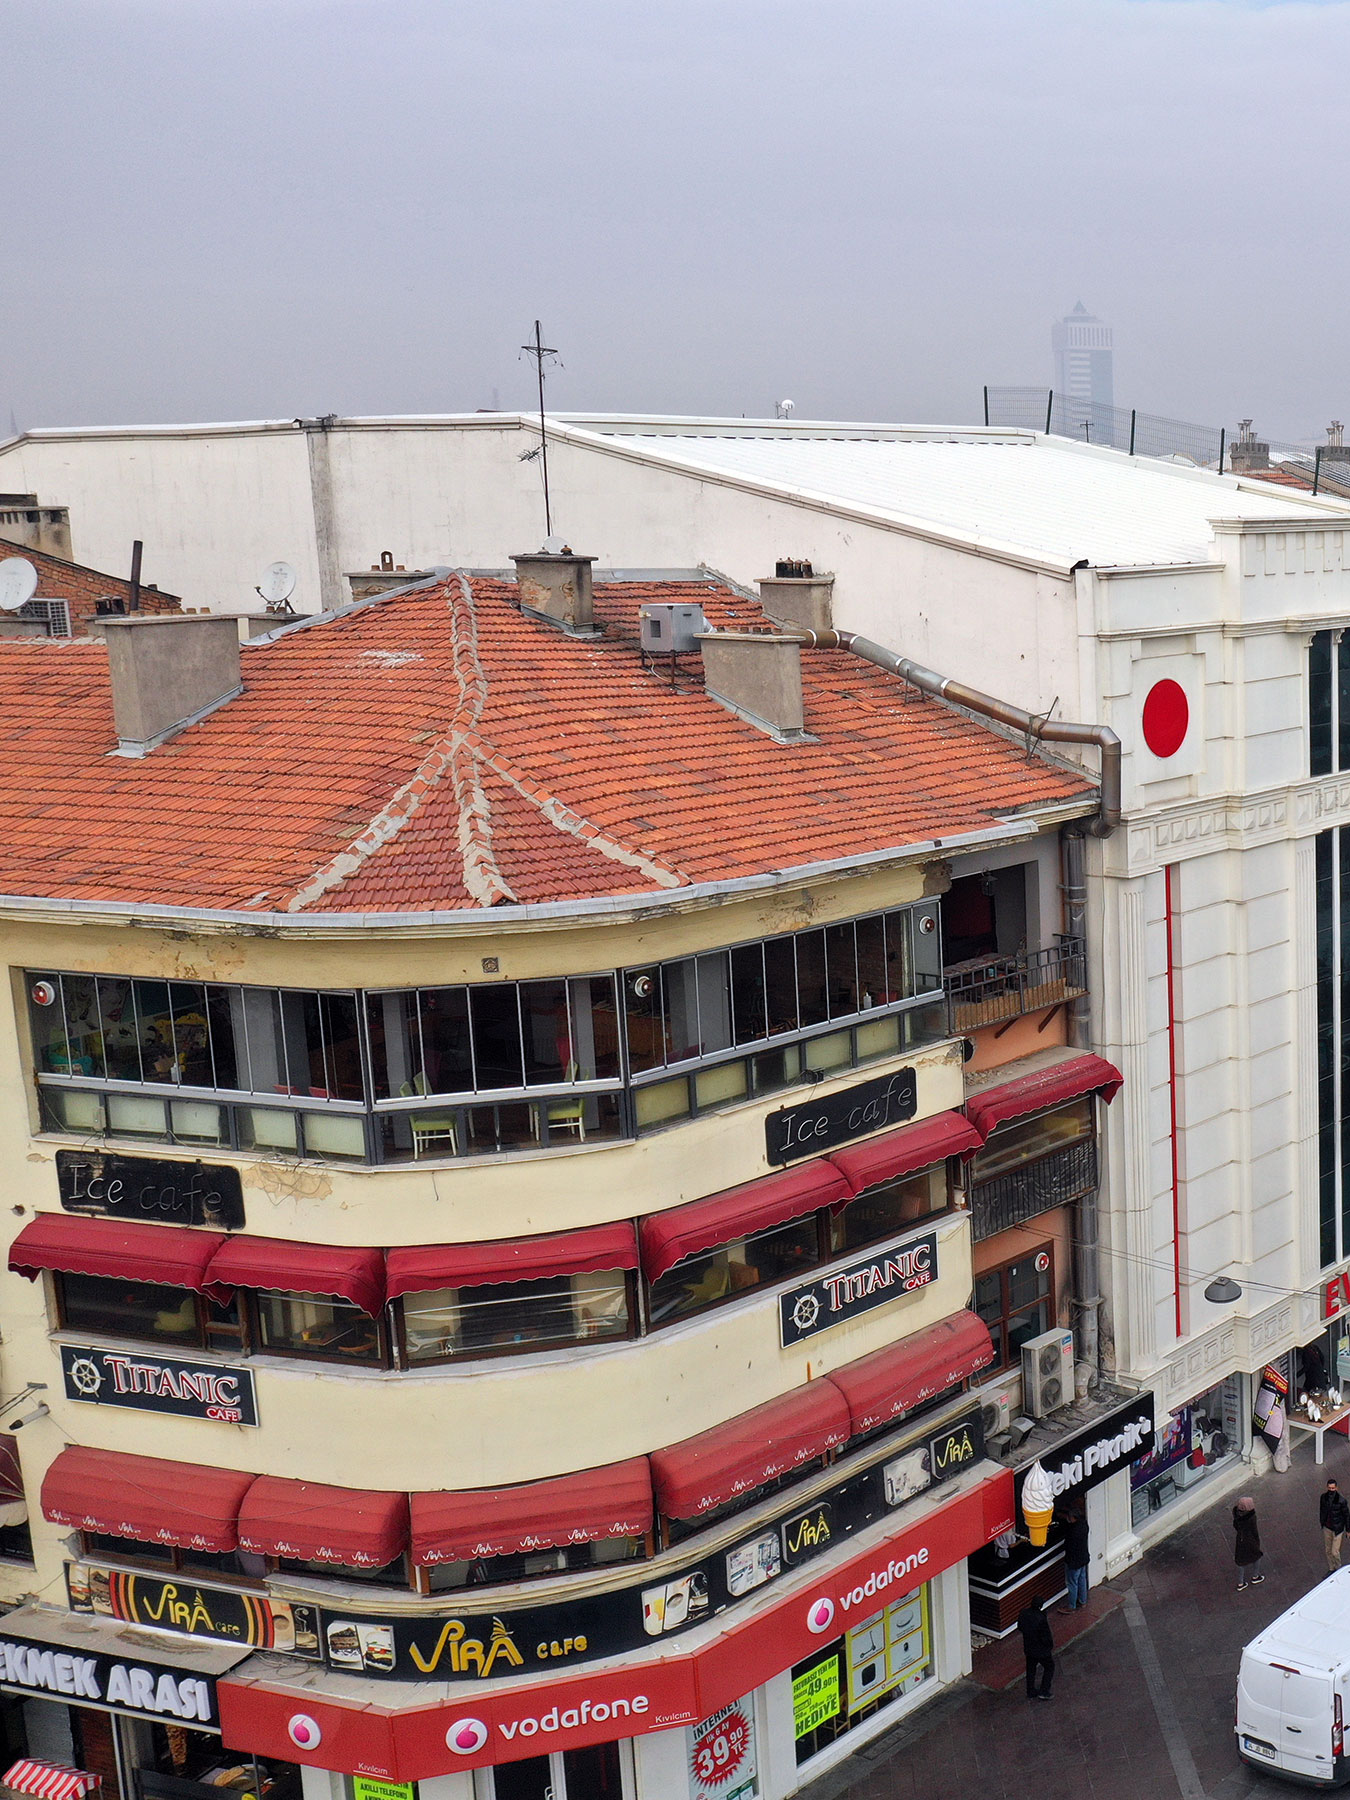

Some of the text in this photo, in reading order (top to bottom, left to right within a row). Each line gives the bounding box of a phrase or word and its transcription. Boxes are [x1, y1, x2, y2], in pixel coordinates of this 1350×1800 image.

[780, 1075, 912, 1151] Ice cafe
[69, 1164, 222, 1226] Ice cafe
[823, 1244, 933, 1314] TITANIC
[902, 1271, 933, 1291] CAFE
[103, 1355, 241, 1407] TITANIC
[206, 1406, 241, 1422] CAFE
[1047, 1454, 1083, 1496] eki
[839, 1548, 928, 1611] vodafone
[107, 1664, 211, 1722] ARASI
[498, 1695, 649, 1741] vodafone
[655, 1711, 692, 1723] Kıvılcım
